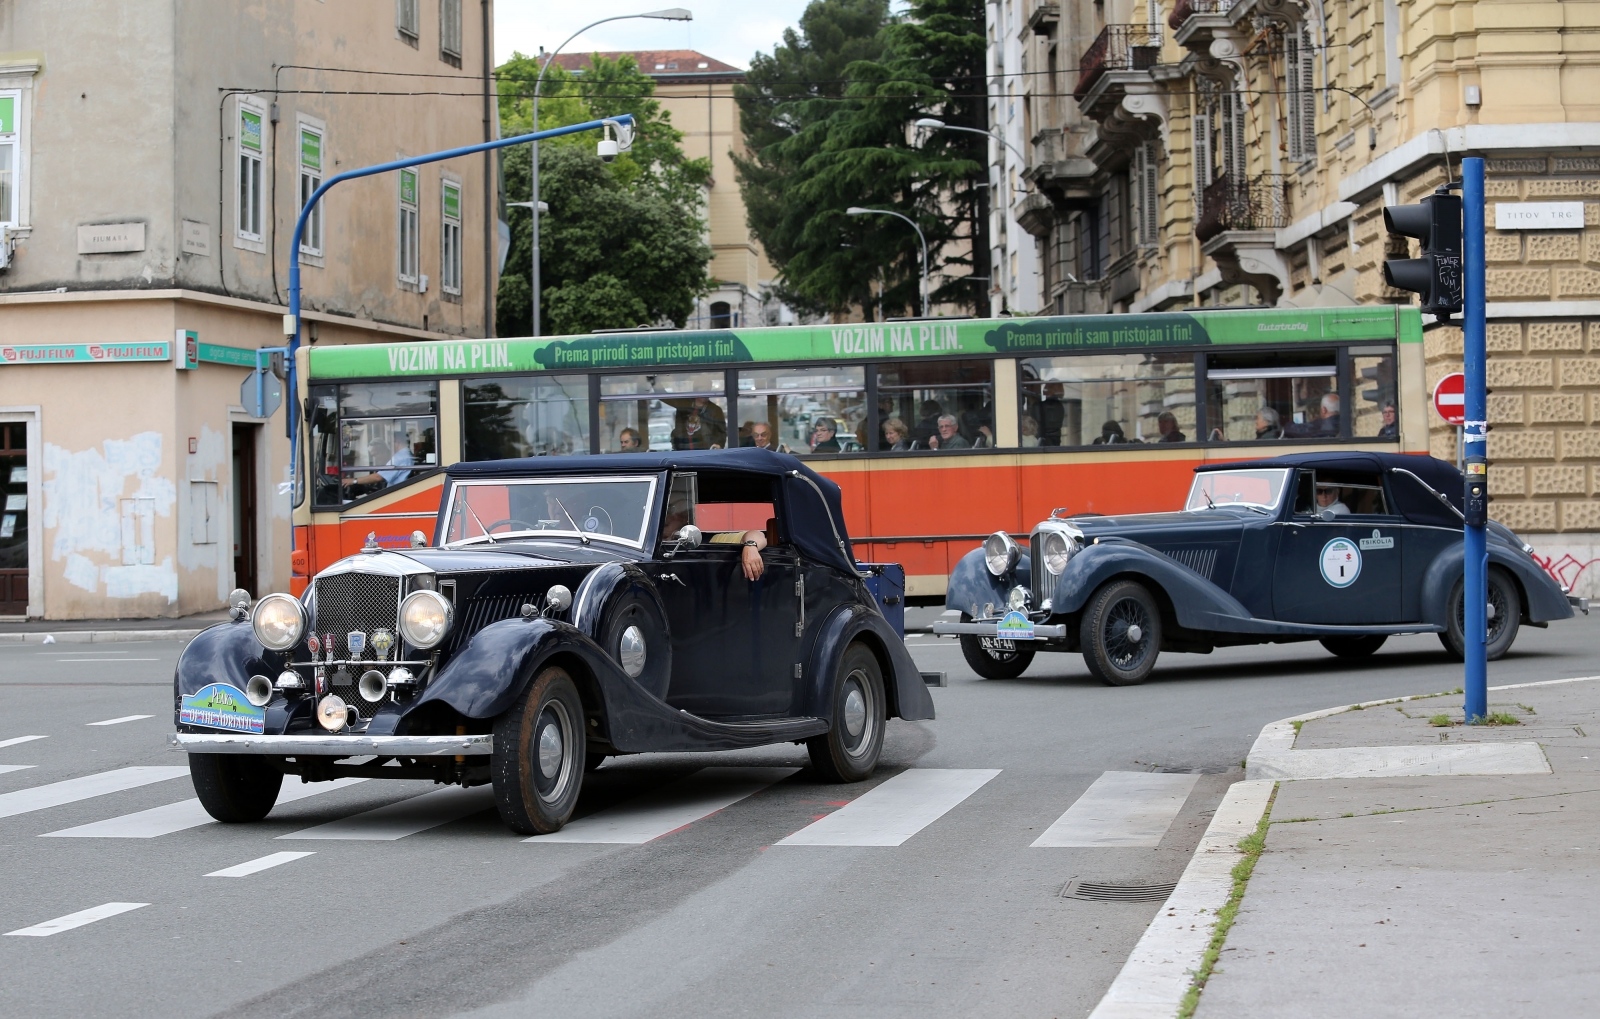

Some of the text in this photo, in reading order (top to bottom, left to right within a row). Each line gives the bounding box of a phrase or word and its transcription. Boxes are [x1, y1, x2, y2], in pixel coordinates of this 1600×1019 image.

[1507, 211, 1573, 219] TITOV TRG
[92, 235, 128, 243] FIUMARA
[831, 325, 963, 354] VOZIM NA PLIN.
[1007, 324, 1192, 349] Prema prirodi sam pristojan i fin!
[20, 350, 46, 360] FUJI
[49, 349, 75, 359] FILM
[107, 347, 134, 357] FUJI
[136, 346, 163, 357] FILM
[388, 343, 513, 372] VOZIM NA PLIN.
[555, 339, 734, 364] Prema prirodi sam pristojan i fin!
[1340, 565, 1345, 577] 1
